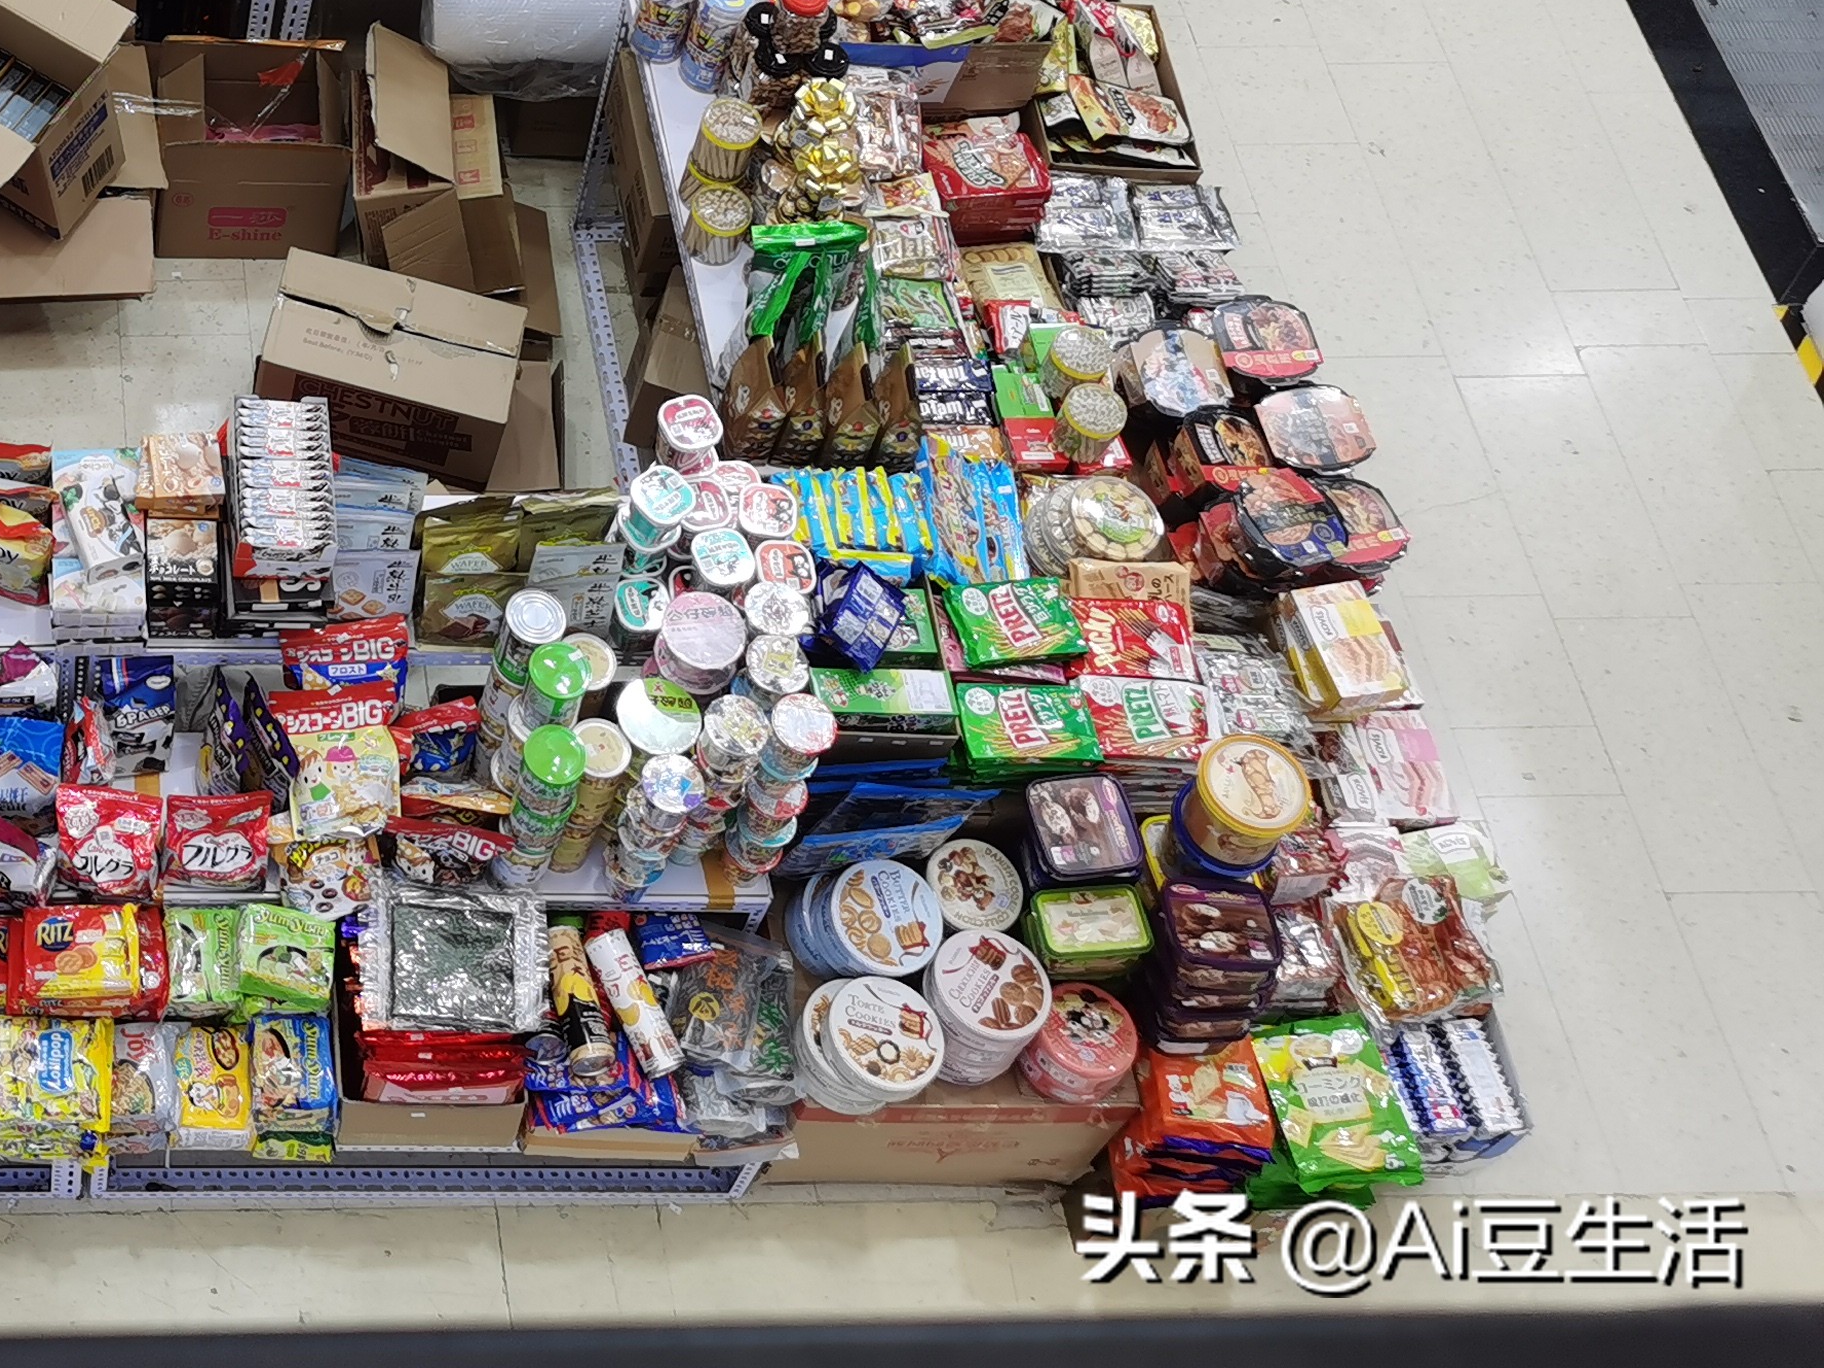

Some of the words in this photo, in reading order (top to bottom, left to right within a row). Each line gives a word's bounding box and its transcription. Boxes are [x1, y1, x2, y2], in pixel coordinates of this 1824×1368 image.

[208, 226, 283, 243] E-shine
[297, 377, 457, 430] CHESTNUT
[990, 582, 1040, 647] PRETZ
[296, 636, 396, 663] シスコンBIG
[114, 704, 172, 729] БРАВЕР
[994, 689, 1039, 747] PRETZ
[1124, 683, 1165, 742] PRETZ
[181, 842, 254, 871] フルグラ
[35, 921, 74, 946] RITZ
